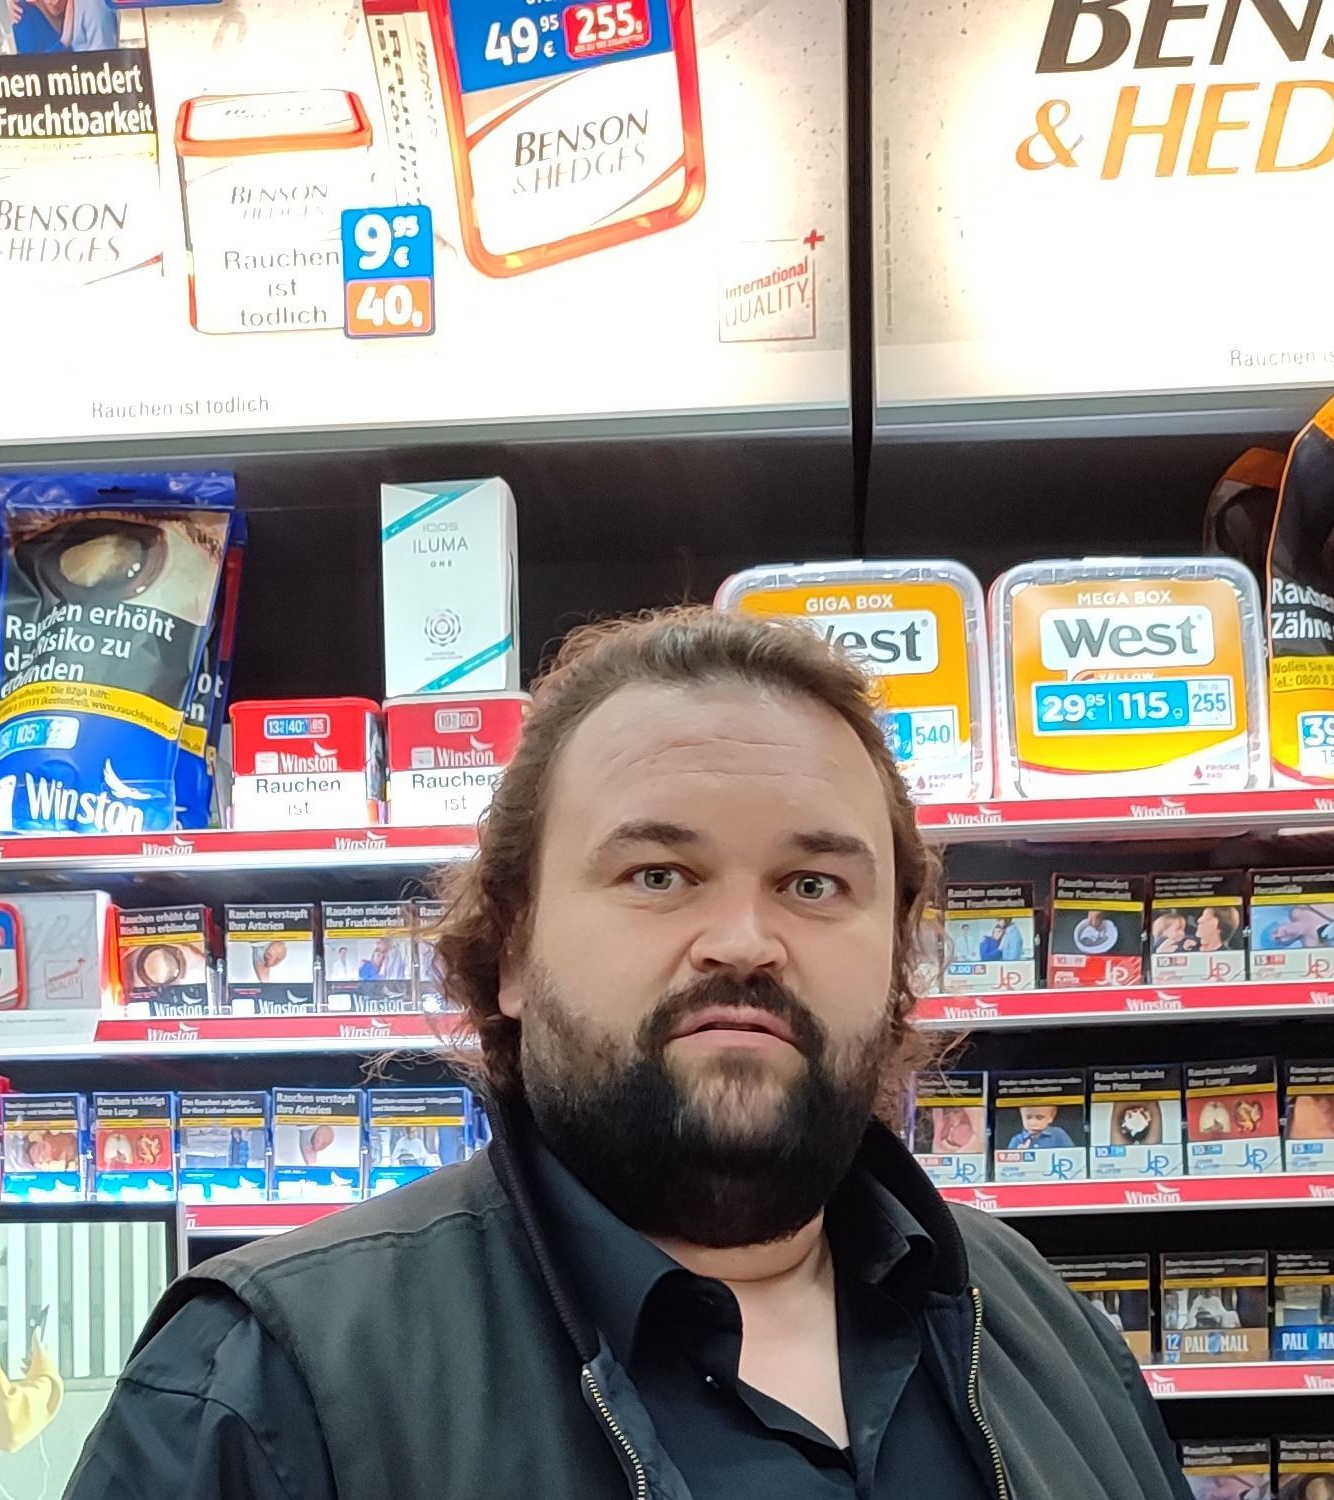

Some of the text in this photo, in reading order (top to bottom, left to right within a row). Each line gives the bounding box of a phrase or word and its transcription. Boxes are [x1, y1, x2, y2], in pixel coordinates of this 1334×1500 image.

[47, 63, 142, 97] mindert
[515, 110, 650, 168] BENSON
[1016, 98, 1085, 172] &
[224, 250, 339, 270] Rauchen
[268, 278, 296, 297] ist
[725, 259, 808, 299] International
[412, 537, 469, 552] ILUMA
[805, 594, 893, 612] GIGA BOX
[1077, 590, 1171, 606] MEGA BOX
[89, 604, 176, 643] erhöht
[1053, 616, 1200, 660] West
[100, 639, 131, 658] zu
[256, 776, 341, 794] Rauchen
[25, 772, 144, 832] Winston
[1220, 1334, 1249, 1351] MALL
[1282, 1333, 1309, 1350] PALL
